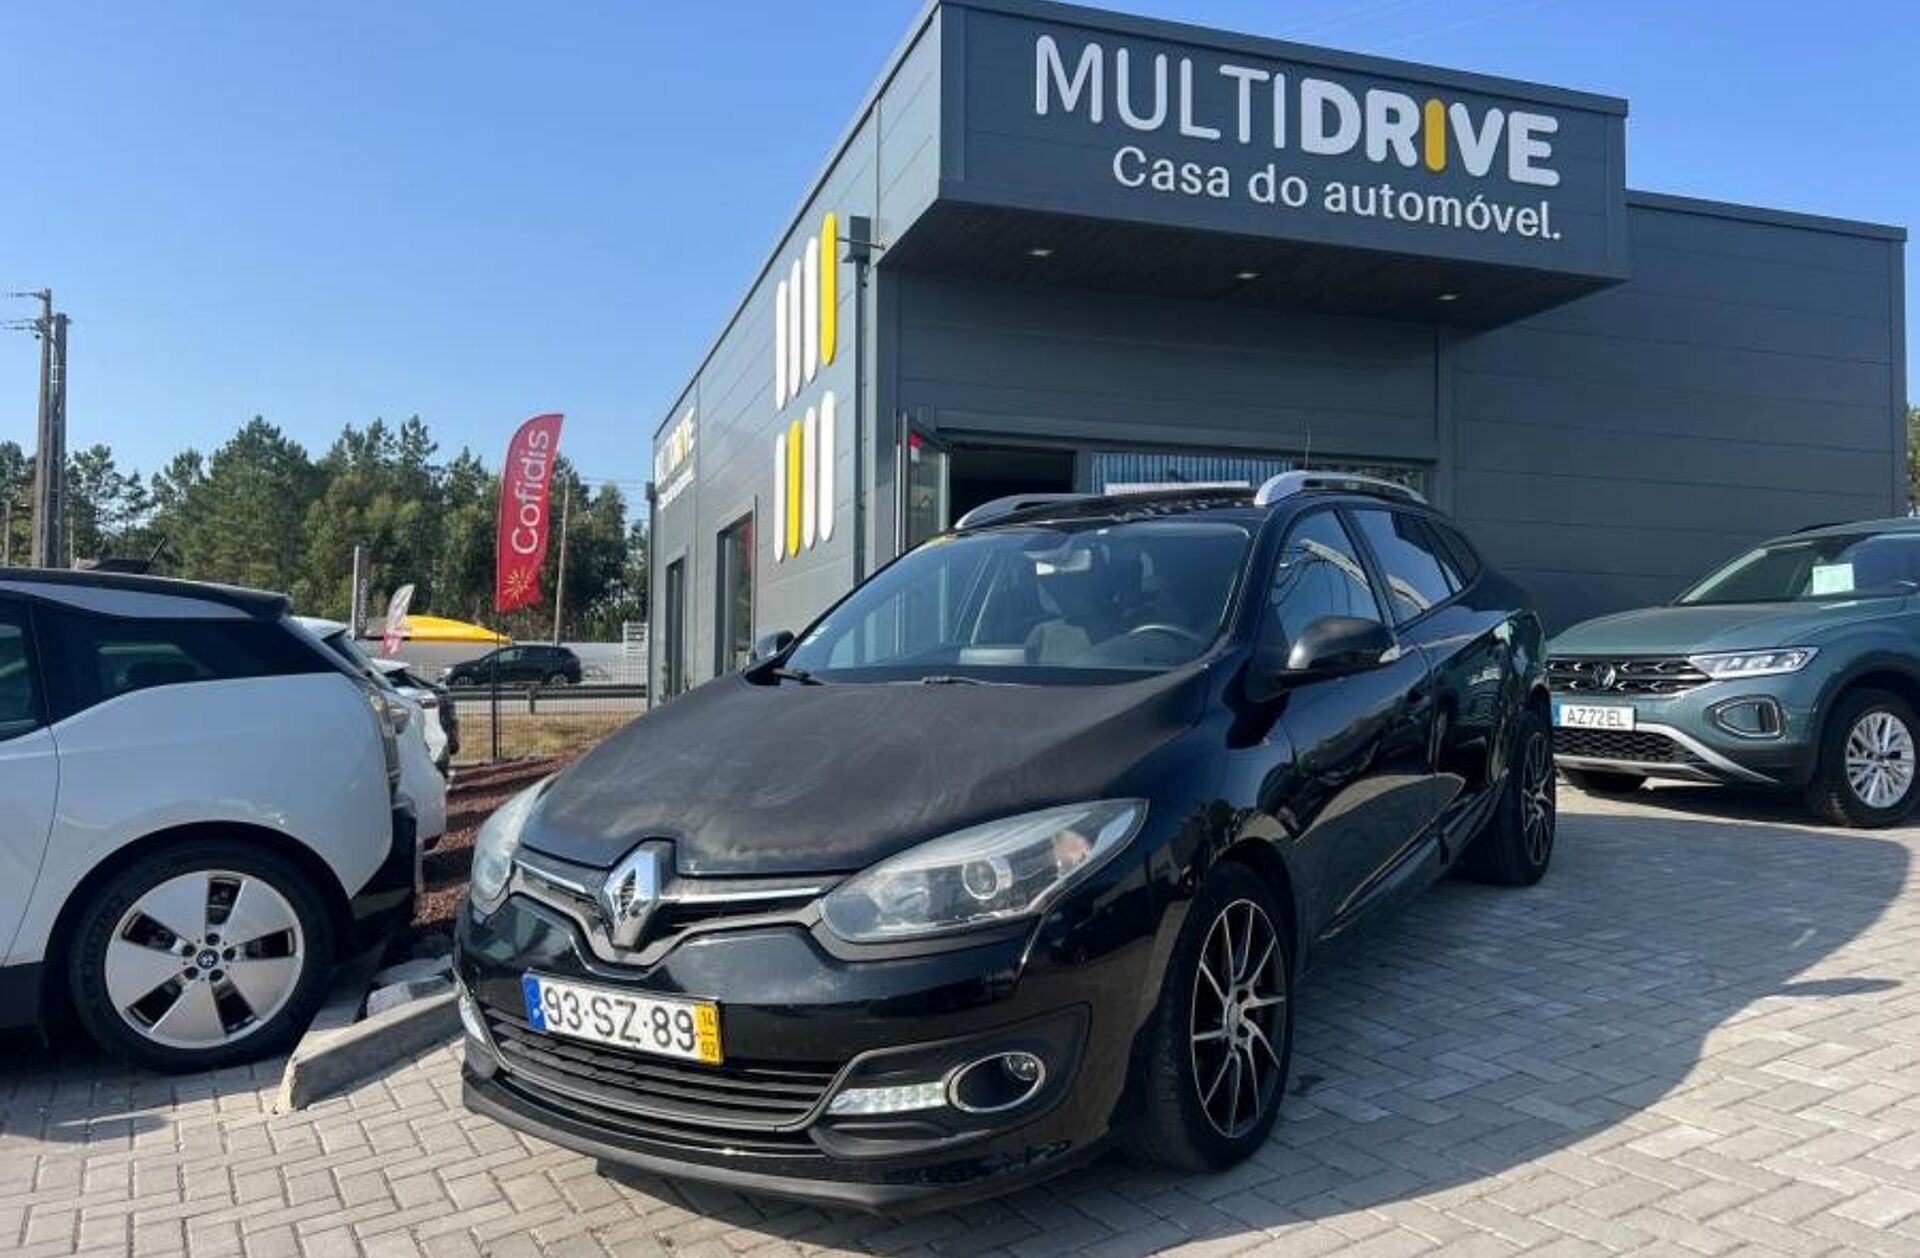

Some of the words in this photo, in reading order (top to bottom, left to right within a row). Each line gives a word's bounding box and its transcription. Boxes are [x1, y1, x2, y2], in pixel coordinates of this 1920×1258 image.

[1036, 34, 1560, 187] MULTIDRIVE
[1113, 146, 1230, 198] Casa
[1248, 163, 1309, 207] do
[1324, 182, 1562, 240] automóvel.
[511, 430, 549, 554] Cofidis
